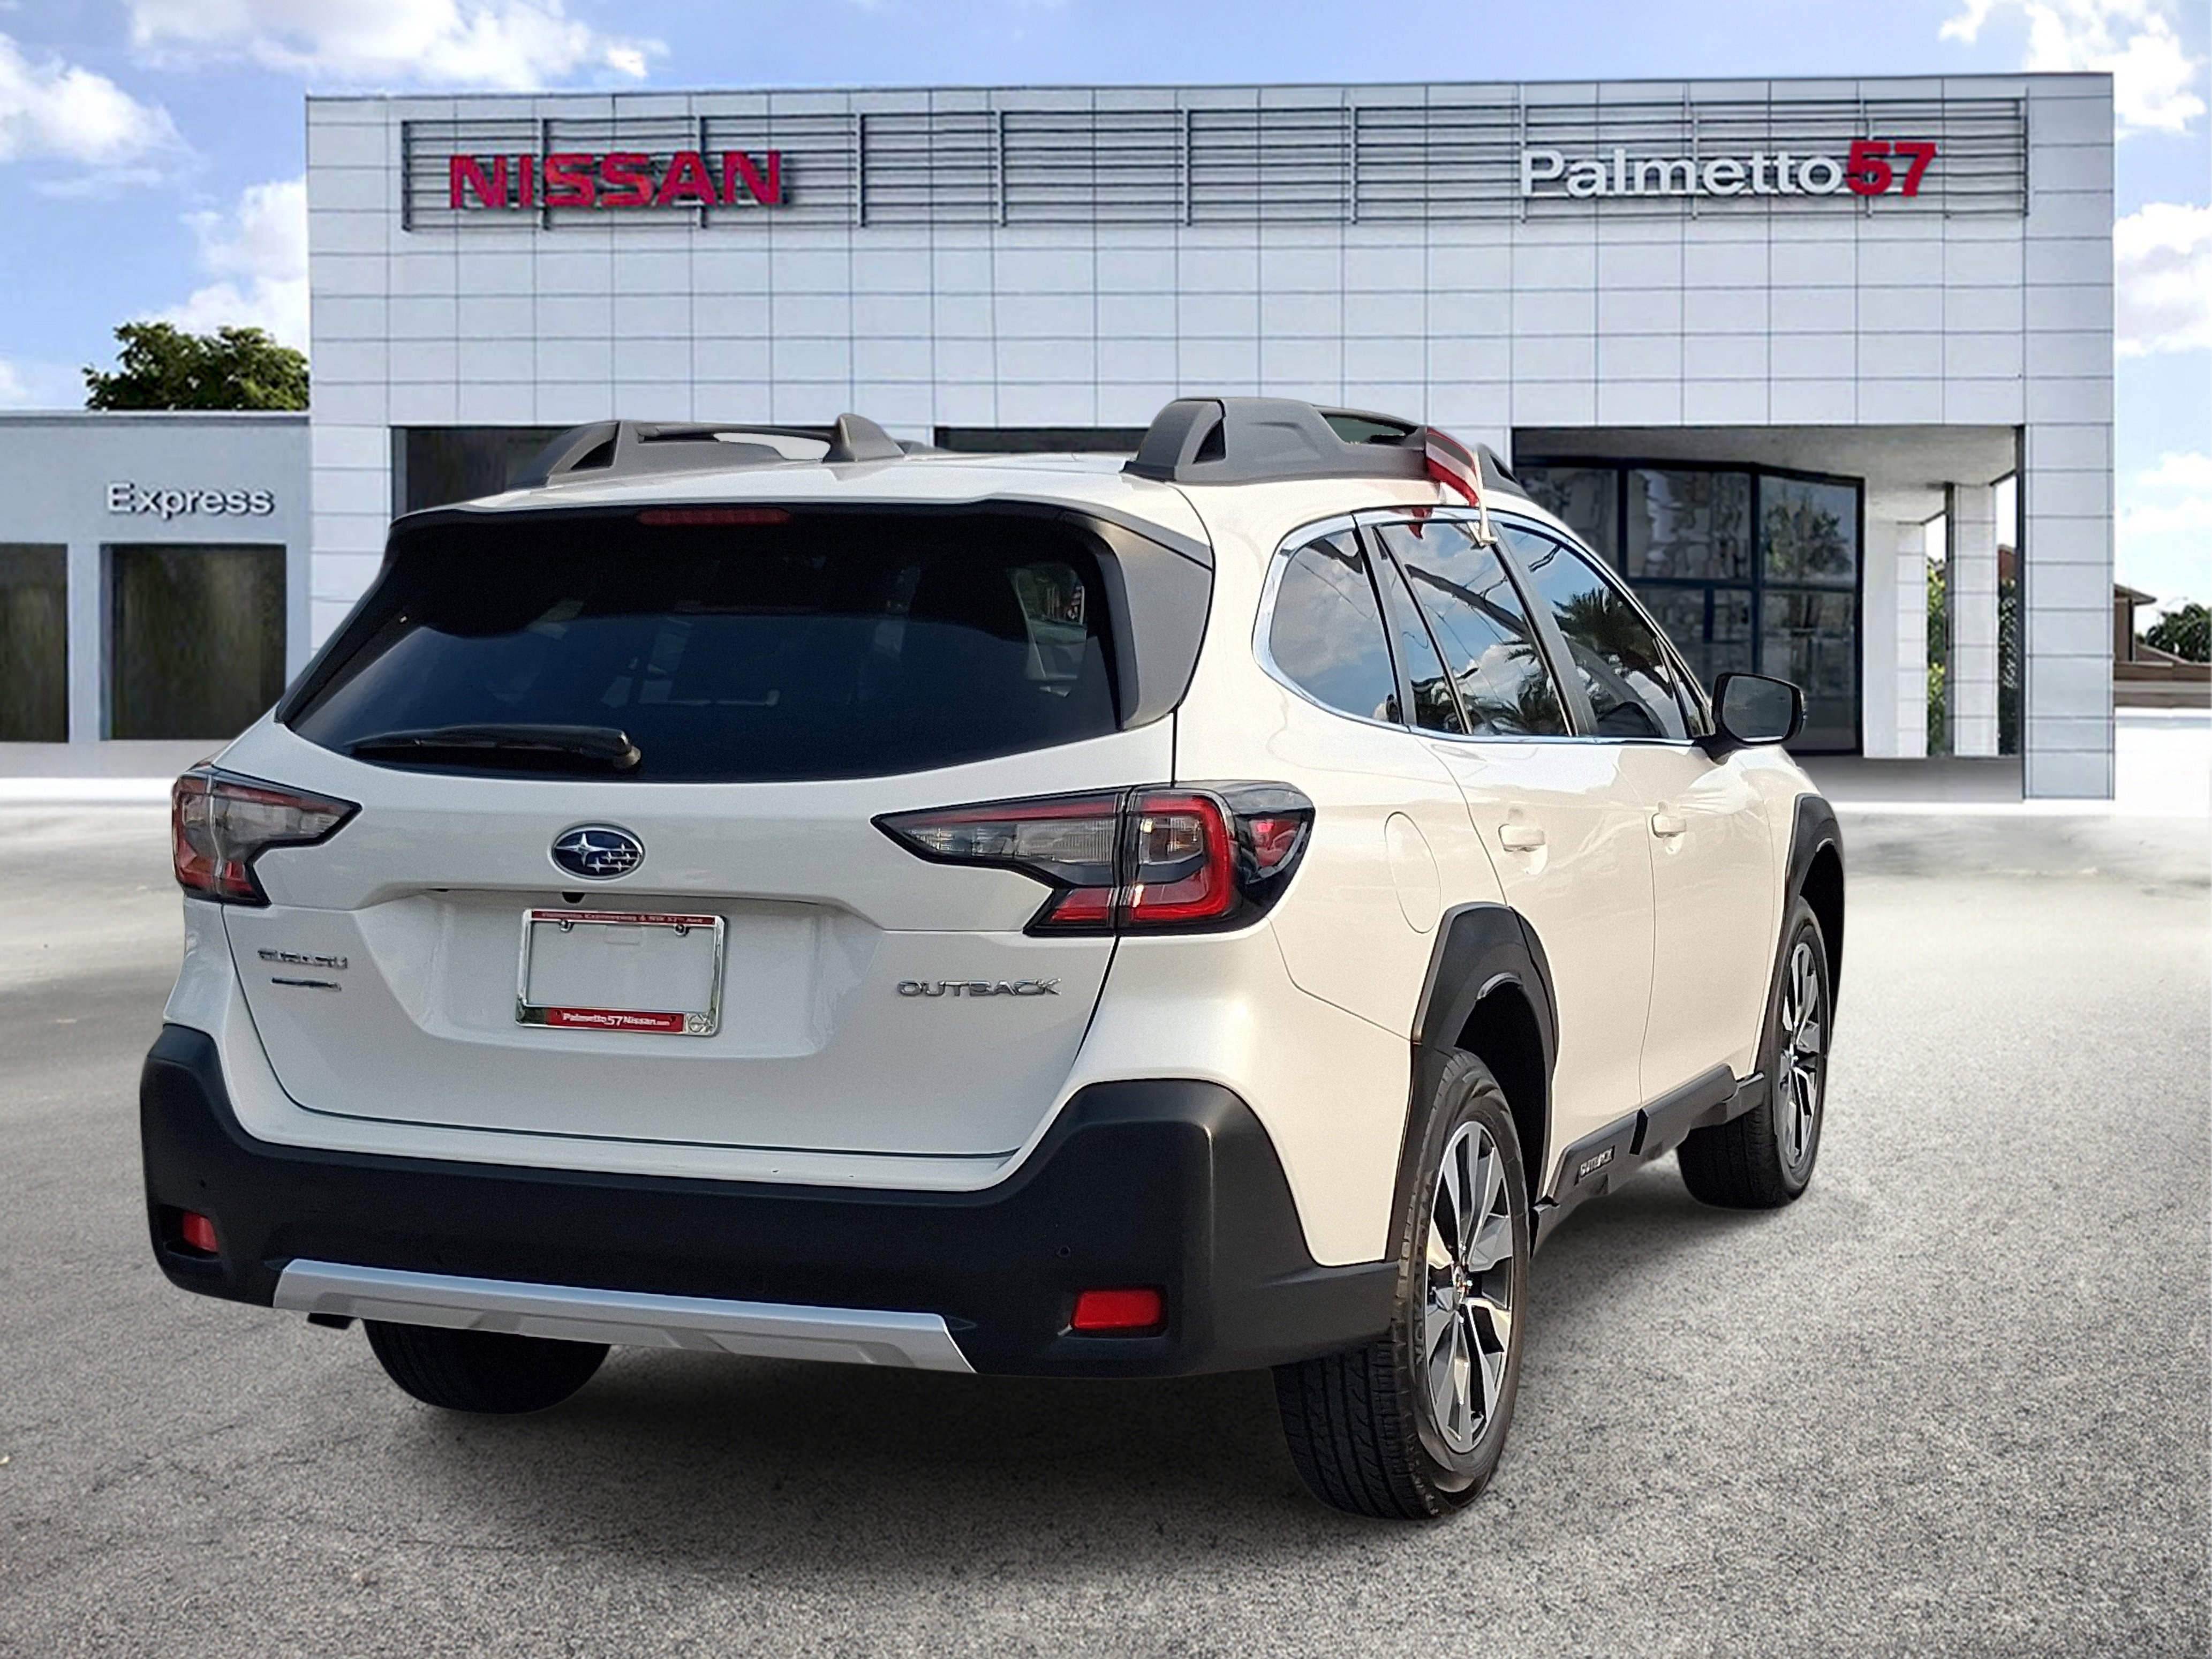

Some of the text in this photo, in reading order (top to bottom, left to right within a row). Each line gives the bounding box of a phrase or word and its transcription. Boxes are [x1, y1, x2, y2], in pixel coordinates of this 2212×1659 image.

[450, 150, 781, 208] NISSAN
[108, 482, 274, 520] Express
[897, 978, 1062, 996] OUTBACK
